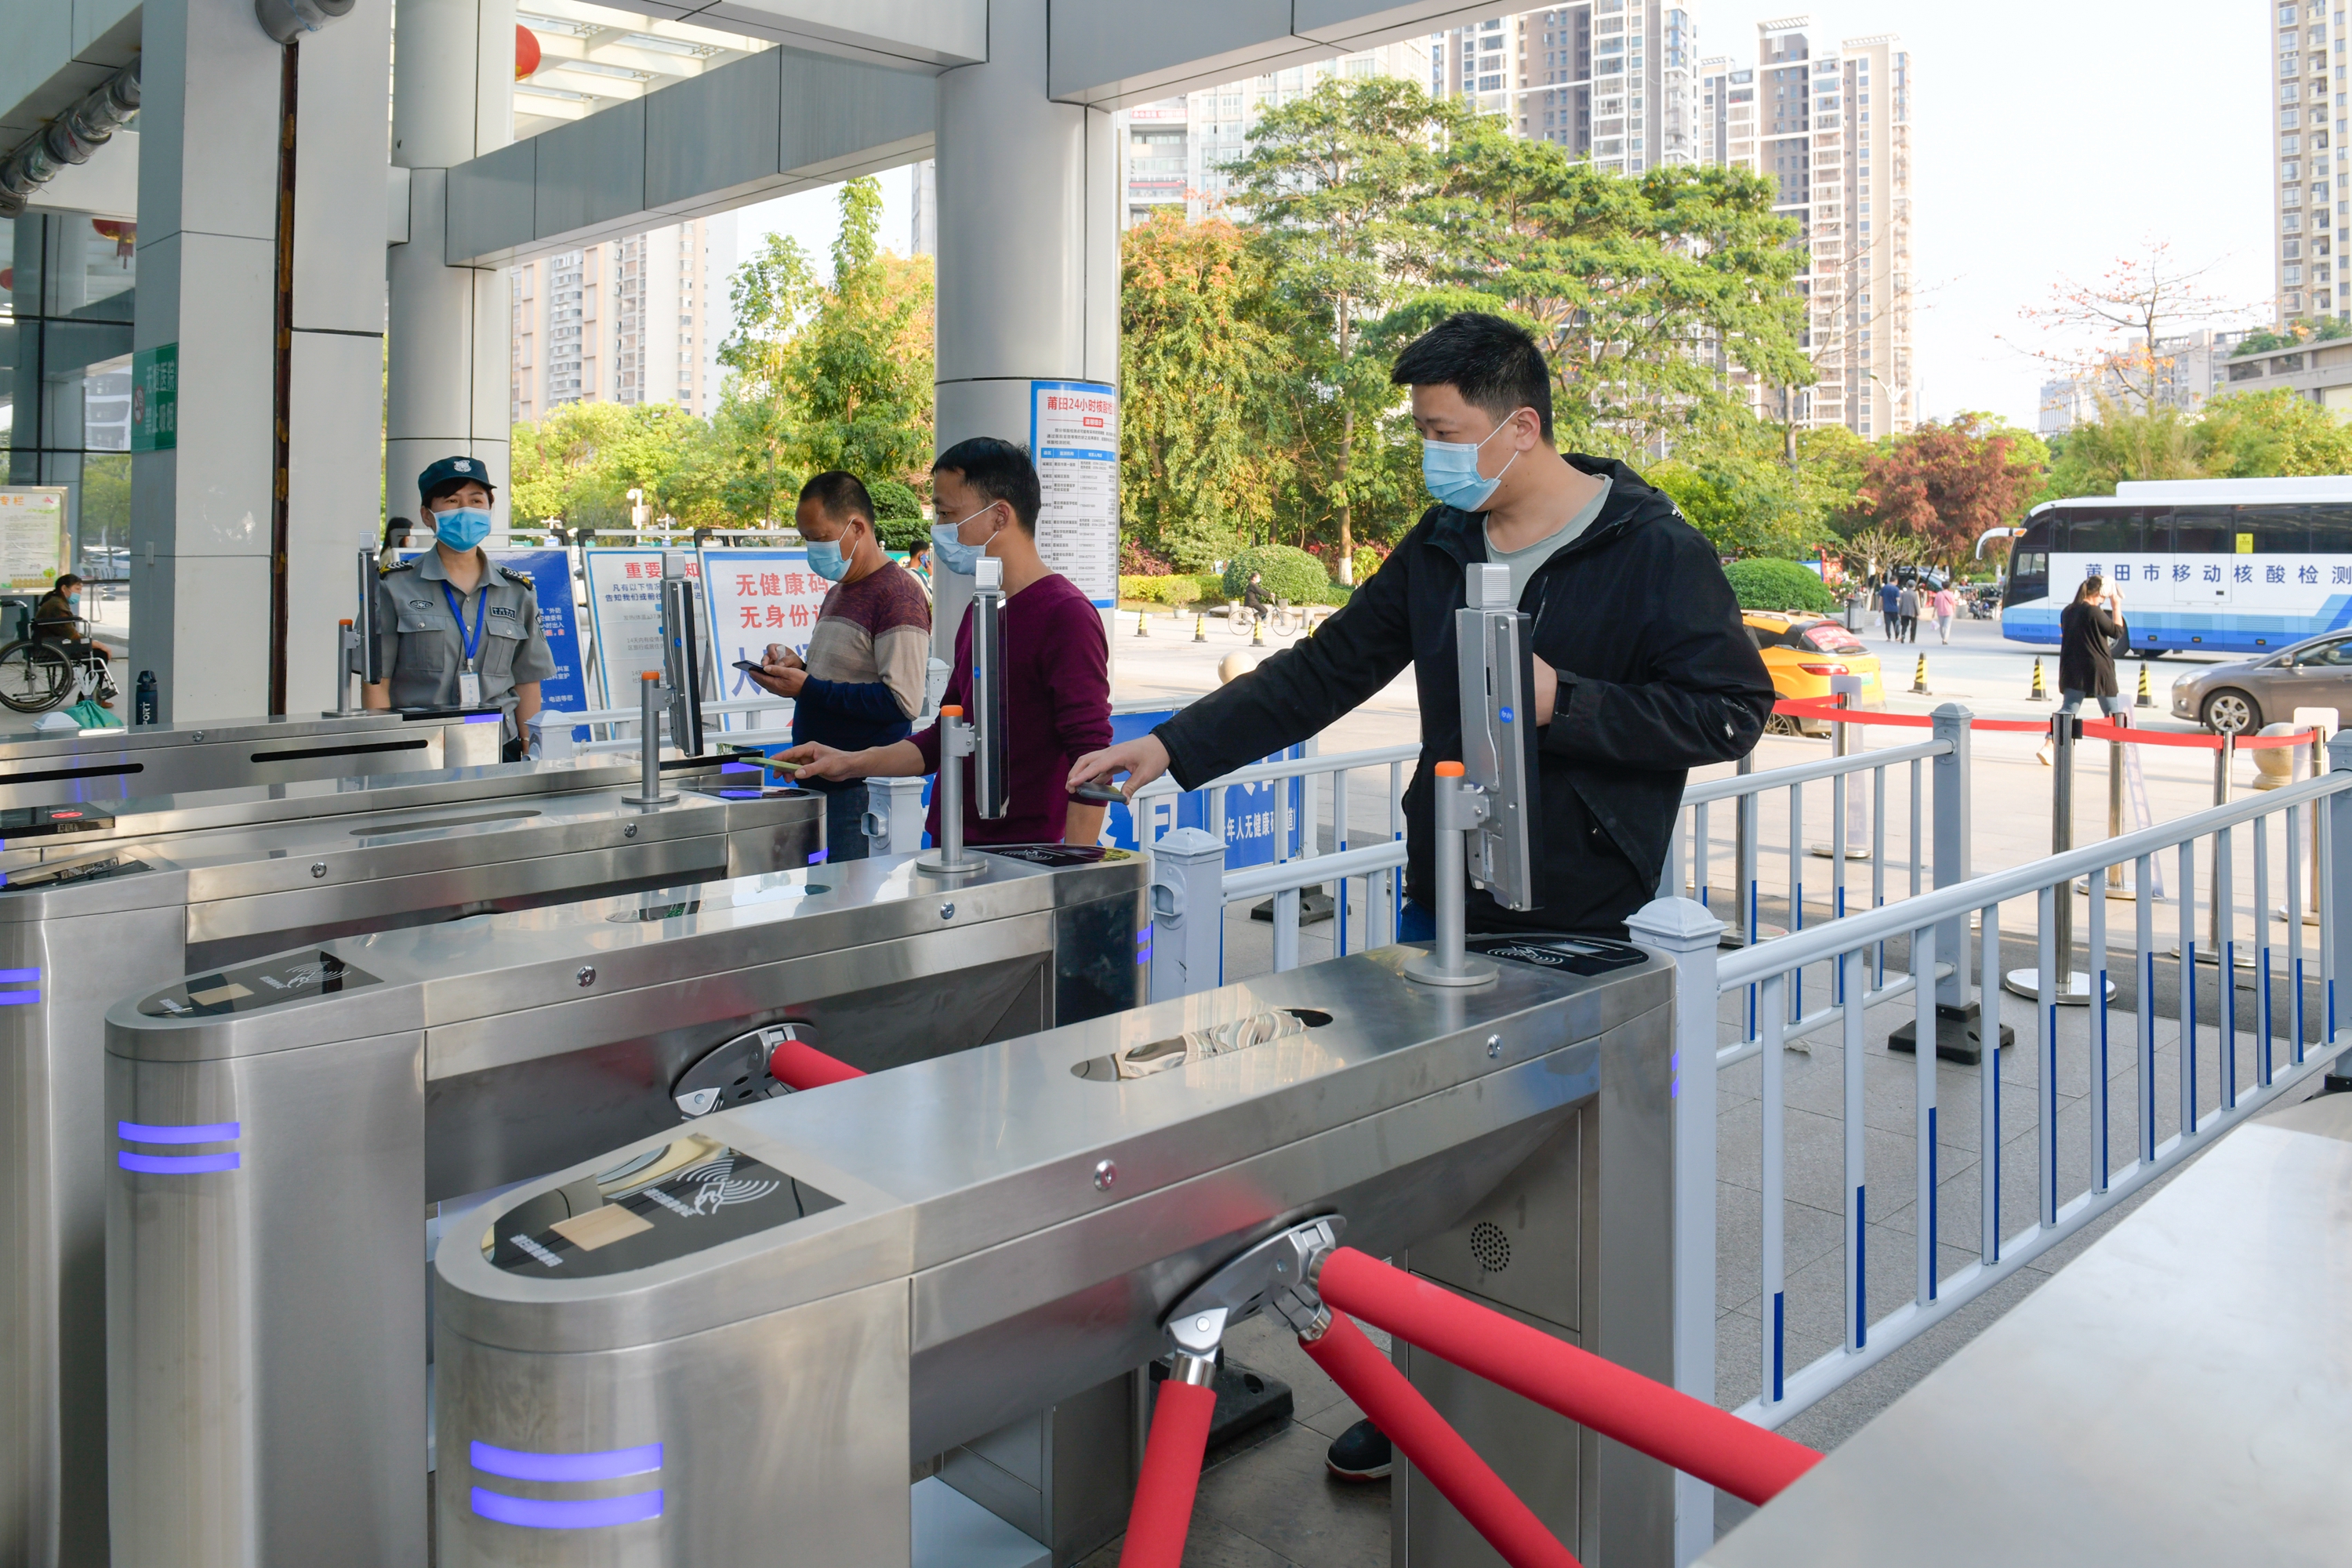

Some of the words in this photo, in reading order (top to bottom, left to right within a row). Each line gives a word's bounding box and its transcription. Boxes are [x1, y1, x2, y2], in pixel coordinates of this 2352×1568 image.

[625, 562, 700, 579] 重要知
[2085, 563, 2352, 585] 莆田市移动核酸检测
[735, 572, 829, 597] 无健康码
